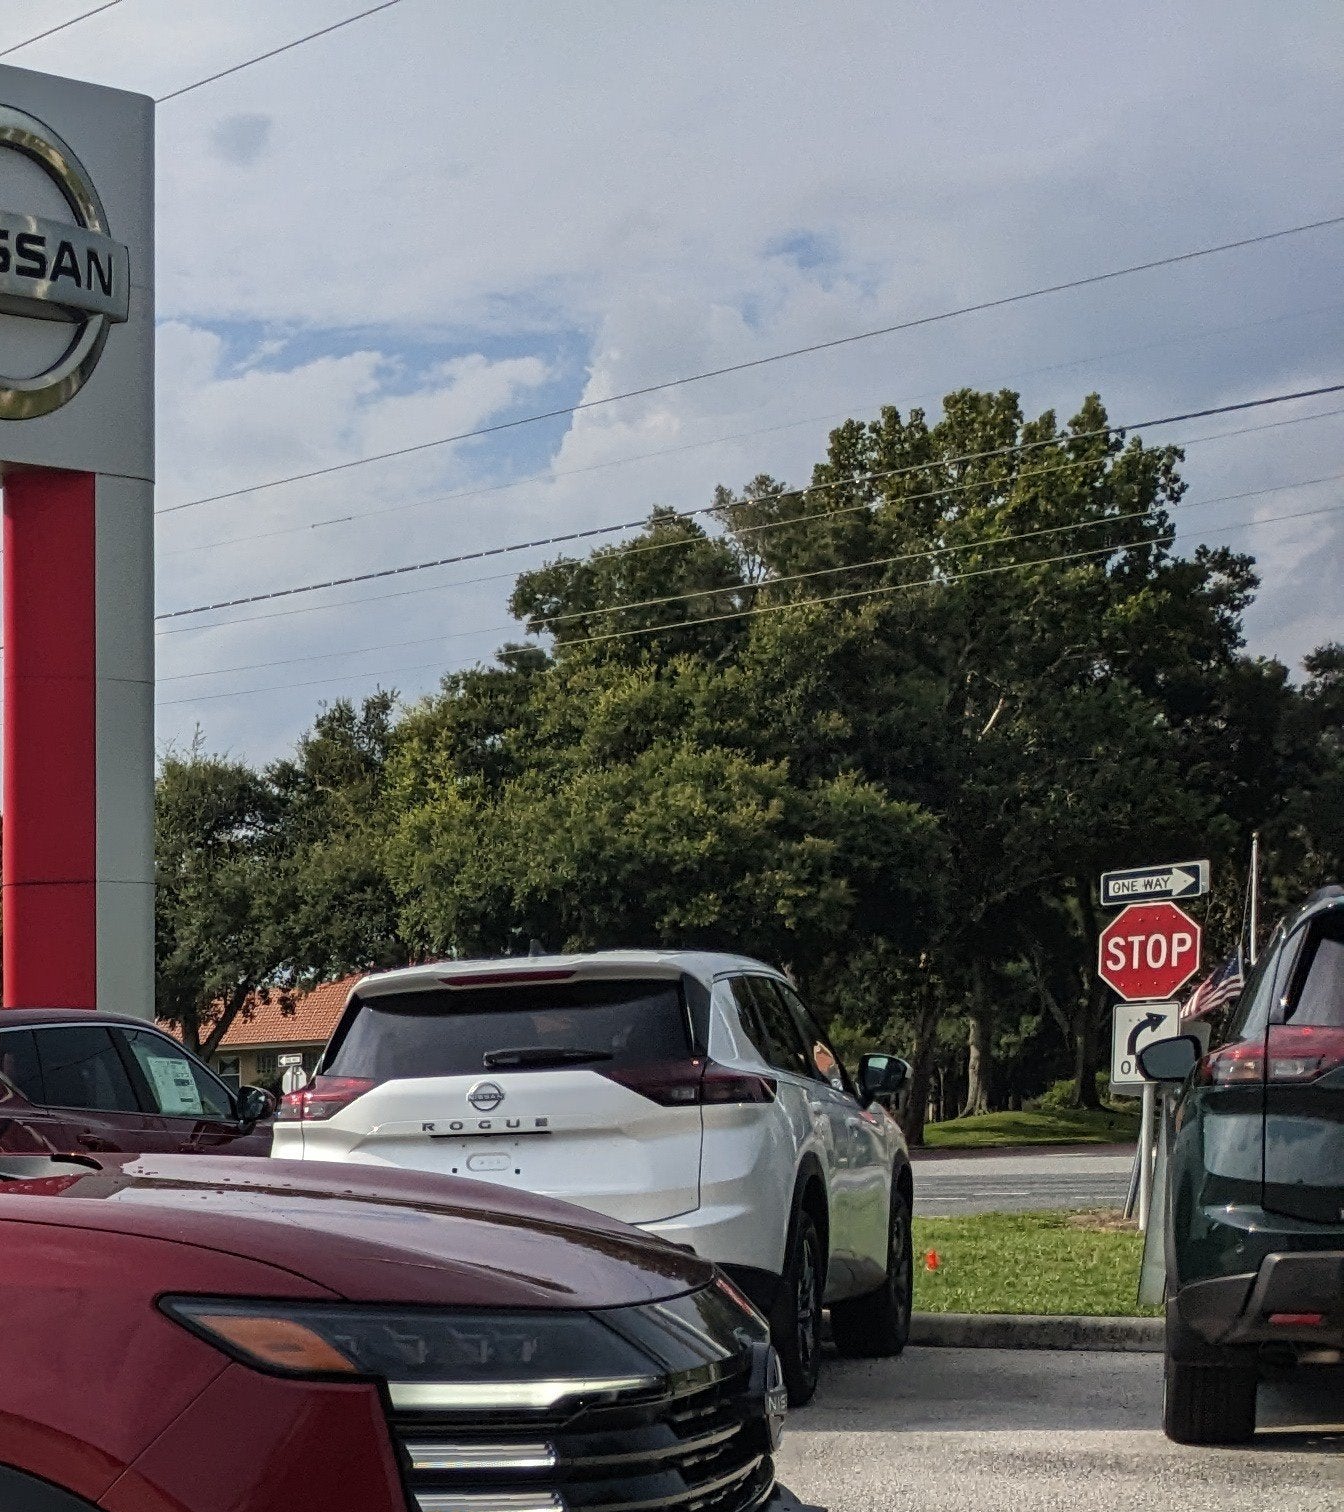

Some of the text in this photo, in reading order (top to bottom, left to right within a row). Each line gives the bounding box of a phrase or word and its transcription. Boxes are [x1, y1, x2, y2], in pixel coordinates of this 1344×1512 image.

[1112, 877, 1171, 893] ONE WAY
[1106, 932, 1192, 971] STOP
[467, 1092, 506, 1101] NISSAN
[421, 1118, 548, 1132] ROGUE
